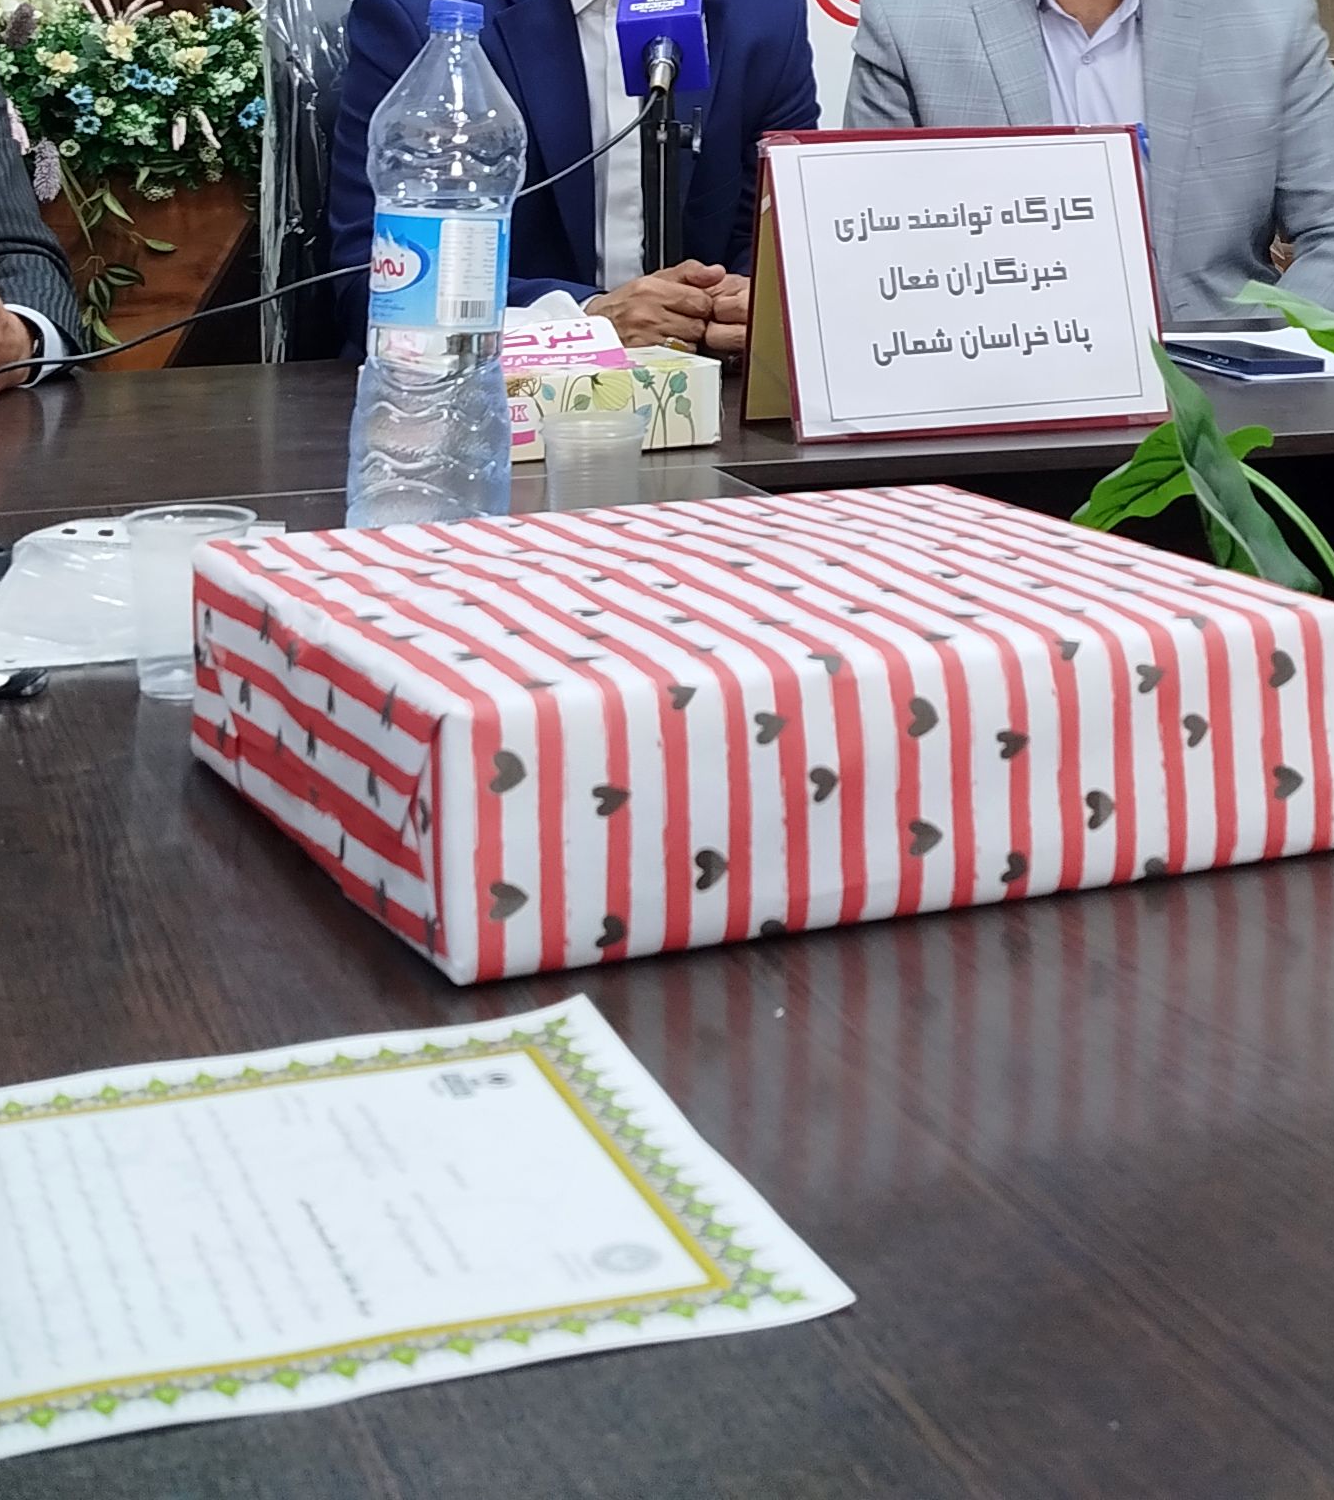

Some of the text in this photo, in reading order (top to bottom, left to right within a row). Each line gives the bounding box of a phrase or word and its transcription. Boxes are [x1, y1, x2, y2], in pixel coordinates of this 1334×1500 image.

[834, 197, 1094, 242] کارگاه توانمند سازی
[879, 257, 1068, 300] خبرنگاران فعال
[873, 319, 1093, 366] پانا خراسان شمالی
